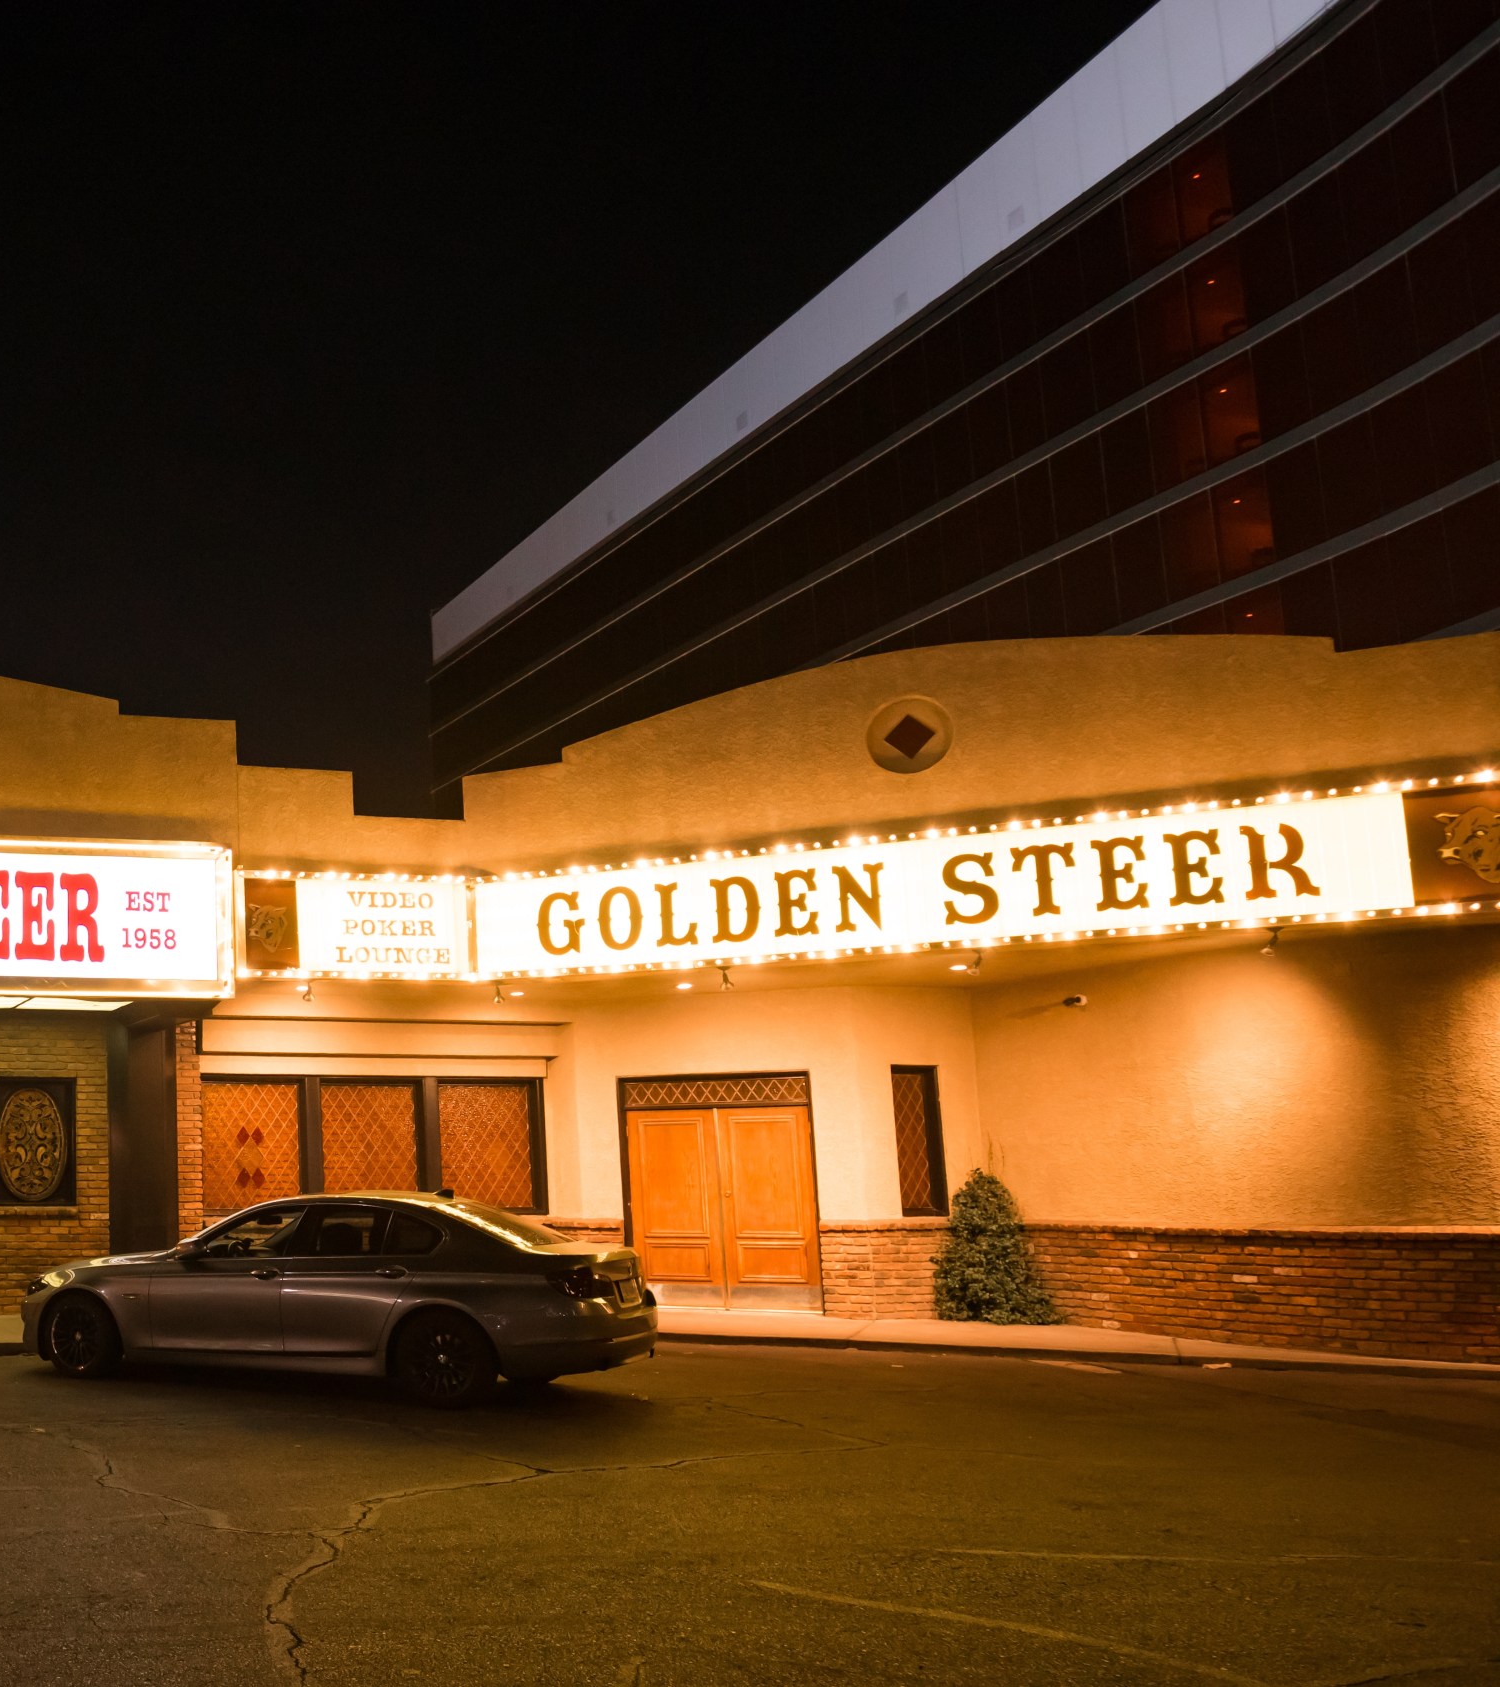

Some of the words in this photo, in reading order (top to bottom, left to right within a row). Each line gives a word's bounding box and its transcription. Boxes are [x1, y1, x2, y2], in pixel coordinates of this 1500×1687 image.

[536, 862, 884, 955] GOLDEN
[942, 823, 1321, 925] STEER
[125, 890, 171, 912] EST
[346, 890, 434, 909] VIDEO
[122, 927, 177, 949] 1958
[342, 919, 436, 937] POKER
[335, 946, 450, 965] LOUNGE
